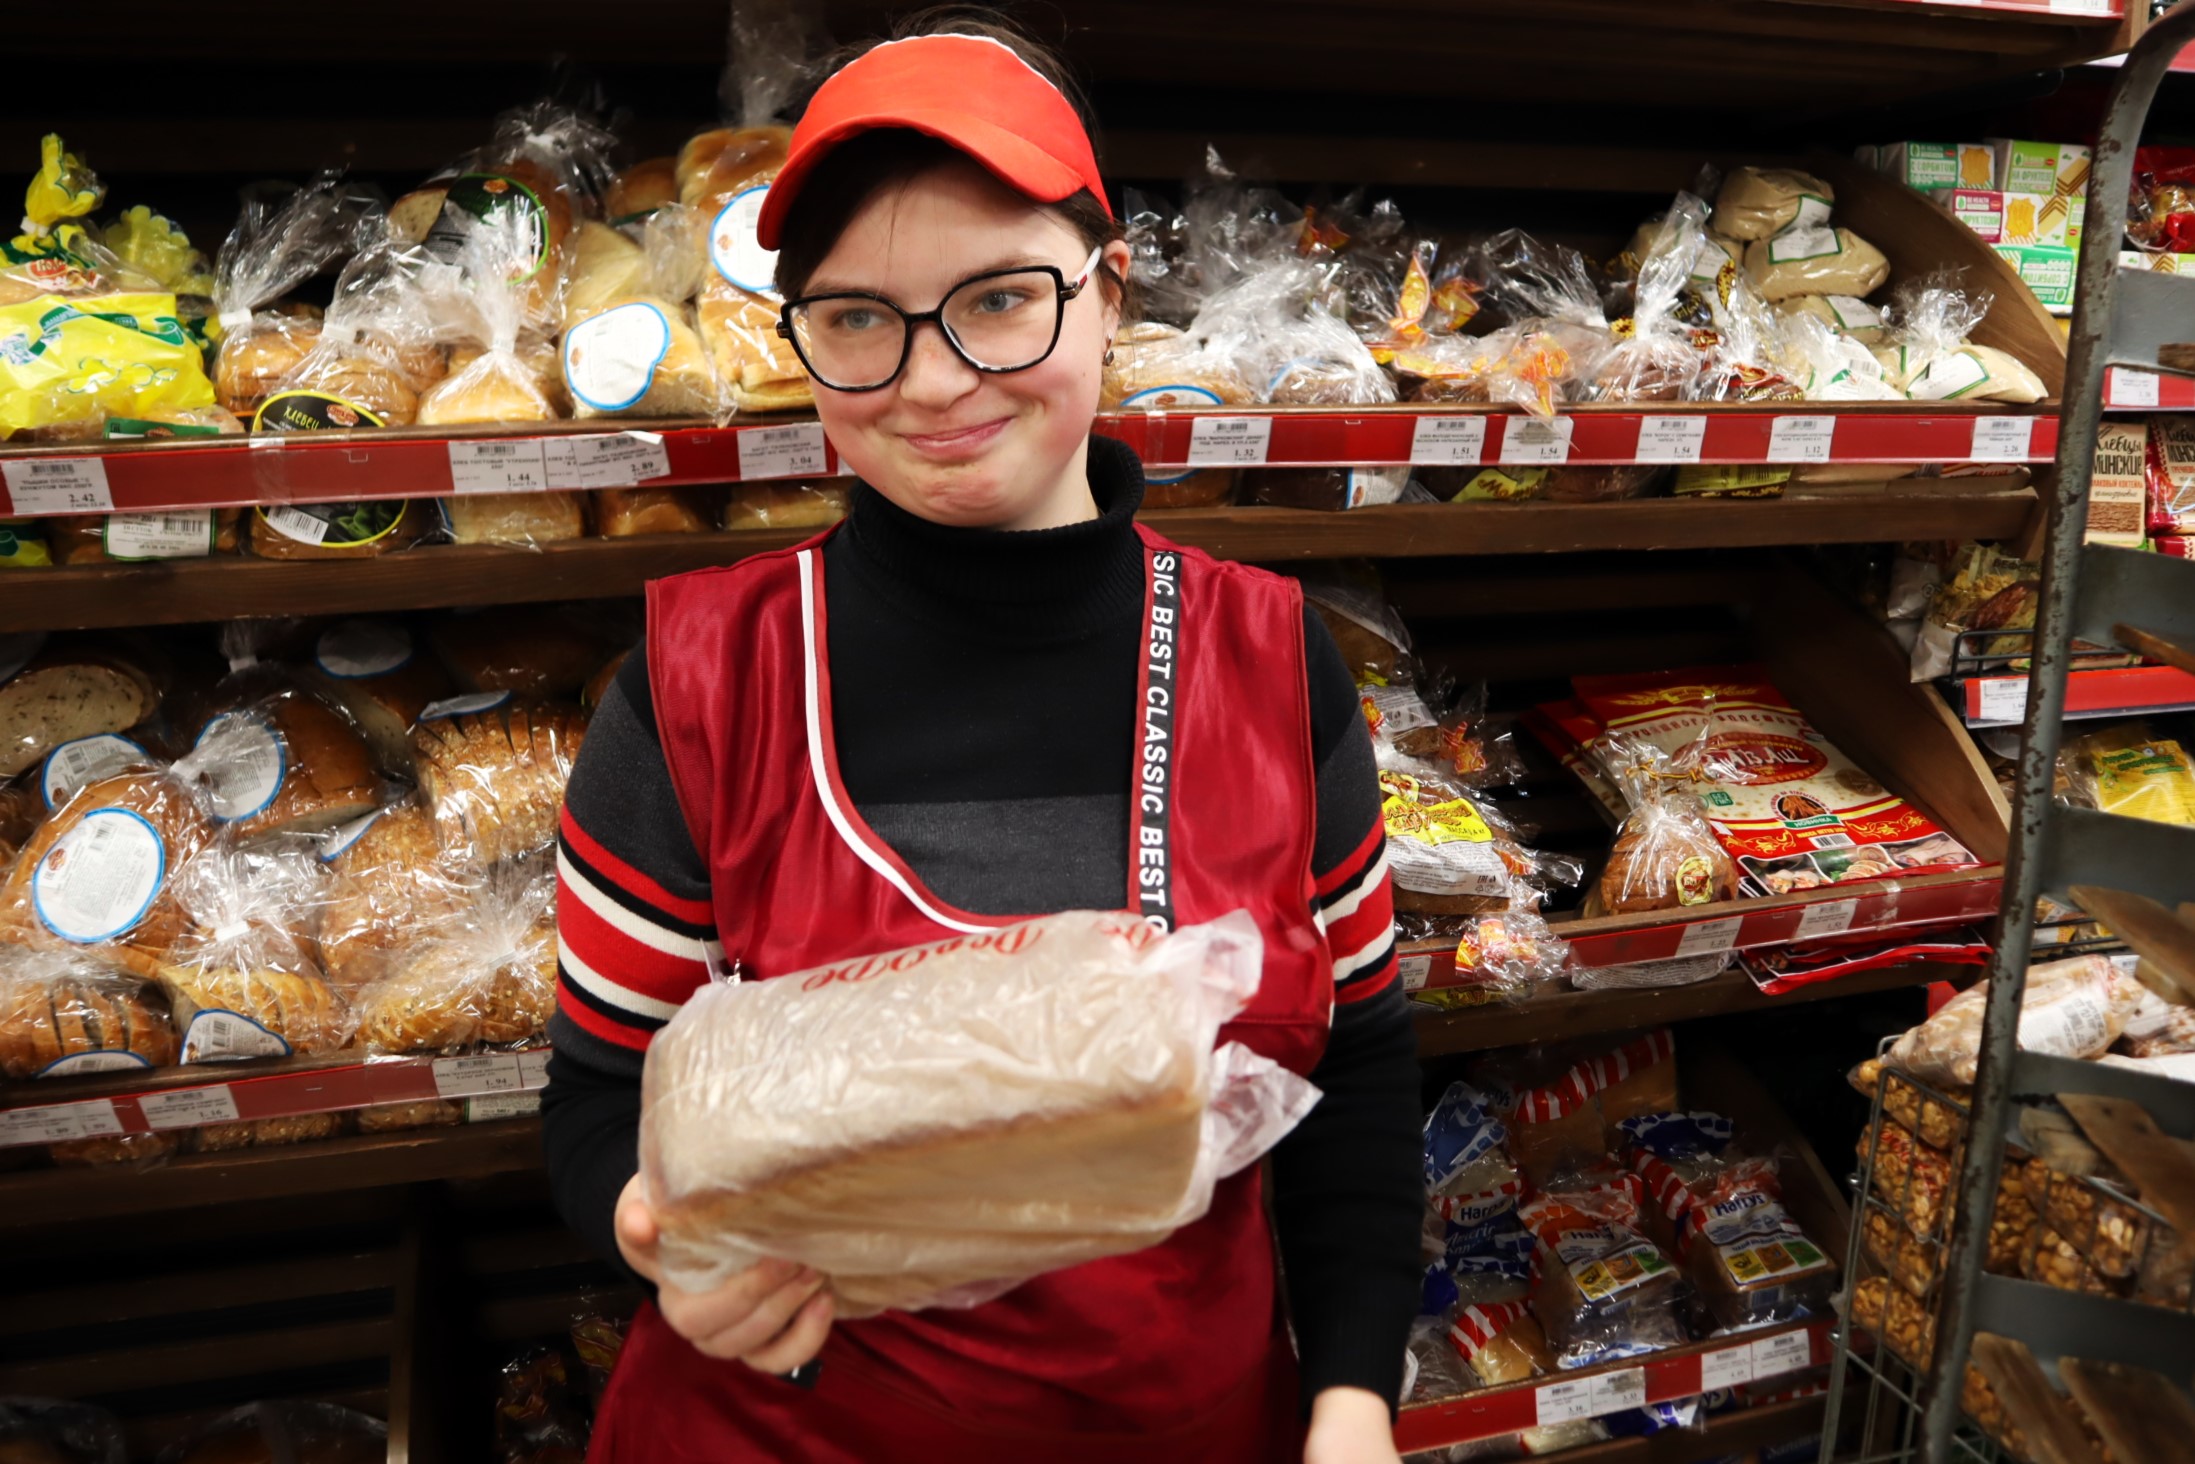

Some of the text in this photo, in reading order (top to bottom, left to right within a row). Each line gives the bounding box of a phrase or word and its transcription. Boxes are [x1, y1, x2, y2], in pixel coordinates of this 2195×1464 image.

[69, 493, 95, 503] 2.42
[507, 473, 530, 482] 1.44
[1152, 553, 1175, 596] SIC
[1149, 605, 1174, 678] BEST
[1143, 686, 1169, 814] CLASSIC
[1139, 826, 1166, 907] BEST
